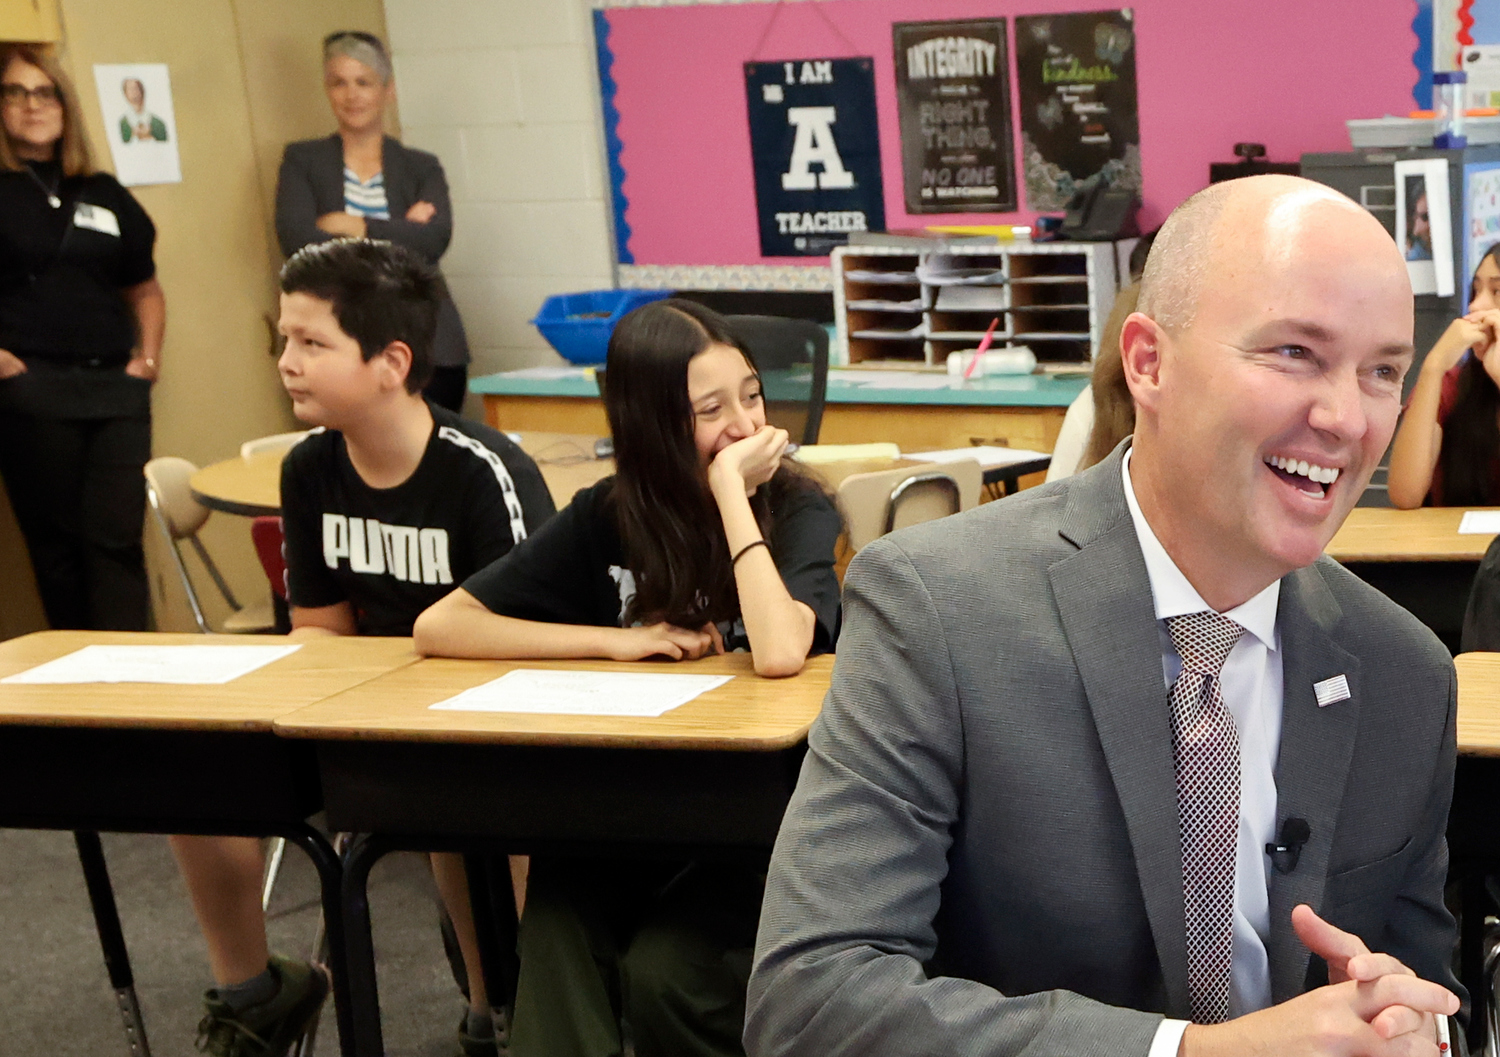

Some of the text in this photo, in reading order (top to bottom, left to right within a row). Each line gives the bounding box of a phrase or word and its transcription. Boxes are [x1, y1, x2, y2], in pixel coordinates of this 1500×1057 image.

[907, 36, 996, 79] INTEGRITY
[784, 60, 834, 85] I AM
[920, 100, 989, 124] RIGHT
[781, 106, 855, 190] A
[921, 165, 996, 186] NO ONE
[774, 211, 868, 234] TEACHER
[322, 512, 454, 585] PUMA
